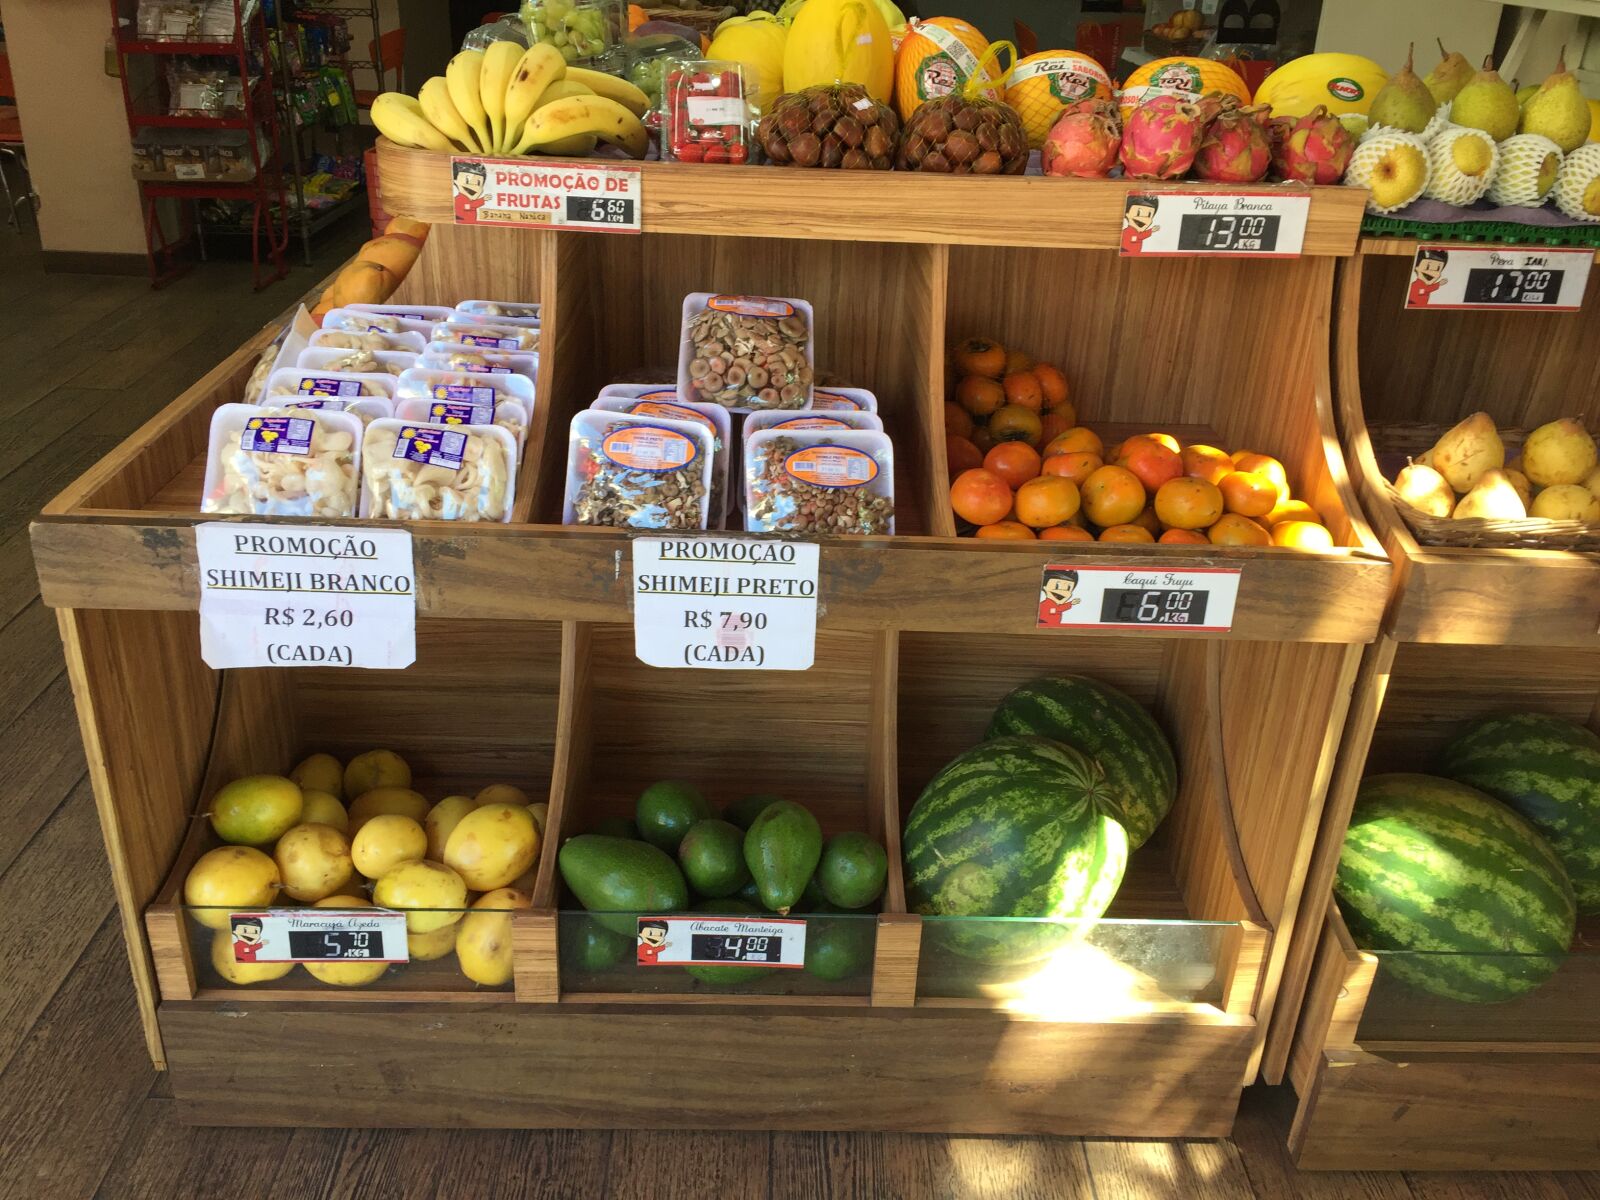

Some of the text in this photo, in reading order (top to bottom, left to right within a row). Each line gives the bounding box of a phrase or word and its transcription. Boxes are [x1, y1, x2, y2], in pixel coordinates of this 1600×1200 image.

[496, 171, 629, 192] PROMOÇÃO DE
[497, 193, 561, 210] FRUTAS
[1193, 197, 1273, 214] Pitaya Branca
[234, 535, 377, 559] PROMOÇÃO
[206, 569, 411, 593] SHIMEJI BRANCO
[637, 575, 815, 596] SHIMEJI PRETO
[264, 607, 354, 628] R$ 2,60
[684, 609, 768, 631] R$ 7,90
[267, 643, 352, 666] (CADA)
[684, 644, 765, 667] (CADA)
[690, 922, 784, 935] Abacate Manteiga
